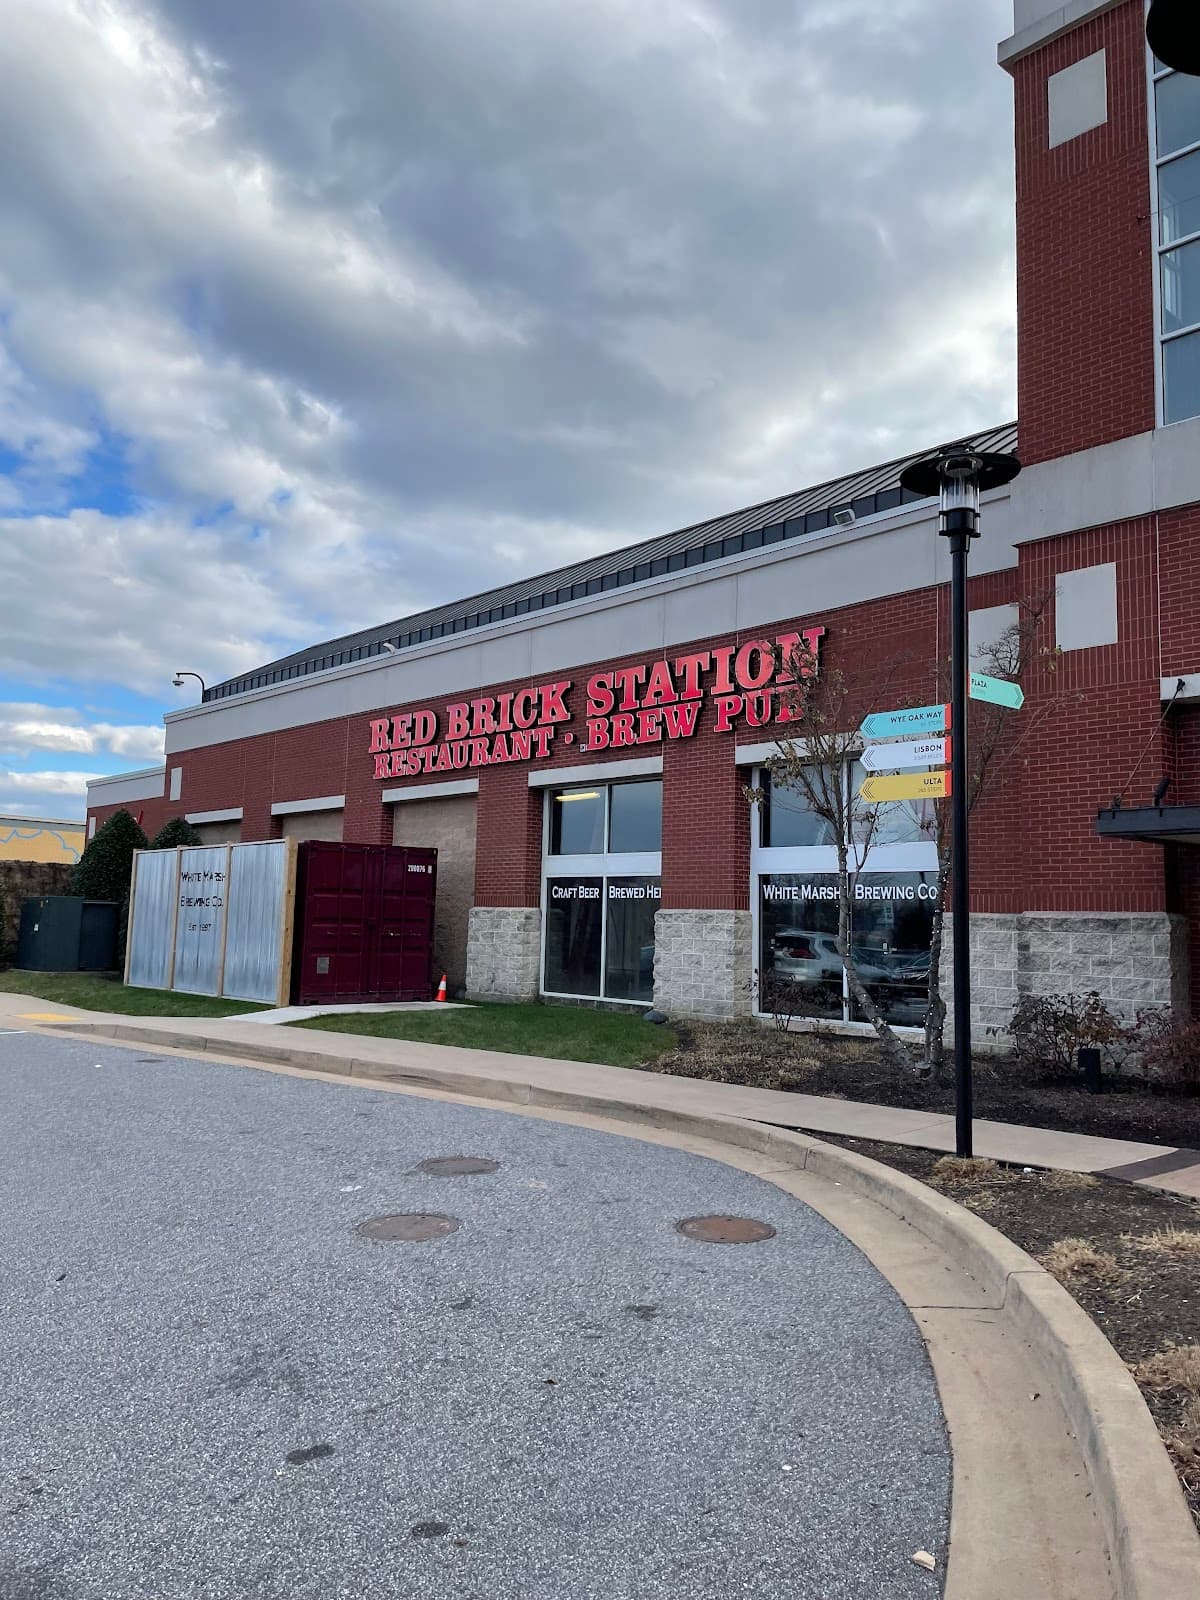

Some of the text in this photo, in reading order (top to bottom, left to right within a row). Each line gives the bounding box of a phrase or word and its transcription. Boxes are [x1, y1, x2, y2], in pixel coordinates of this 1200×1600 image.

[368, 626, 825, 753] RED BRICK STATION
[971, 678, 987, 688] PLAZA
[890, 710, 942, 724] WYE OAK WAY
[373, 683, 804, 779] RESTAURANT BREW PUB
[914, 743, 942, 753] LISBON
[923, 777, 942, 785] ULTA
[552, 886, 600, 899] CRAFT BEER
[608, 885, 645, 899] BREWED
[763, 884, 799, 900] WHITE
[801, 884, 841, 900] MARSH
[855, 884, 915, 900] BREWING
